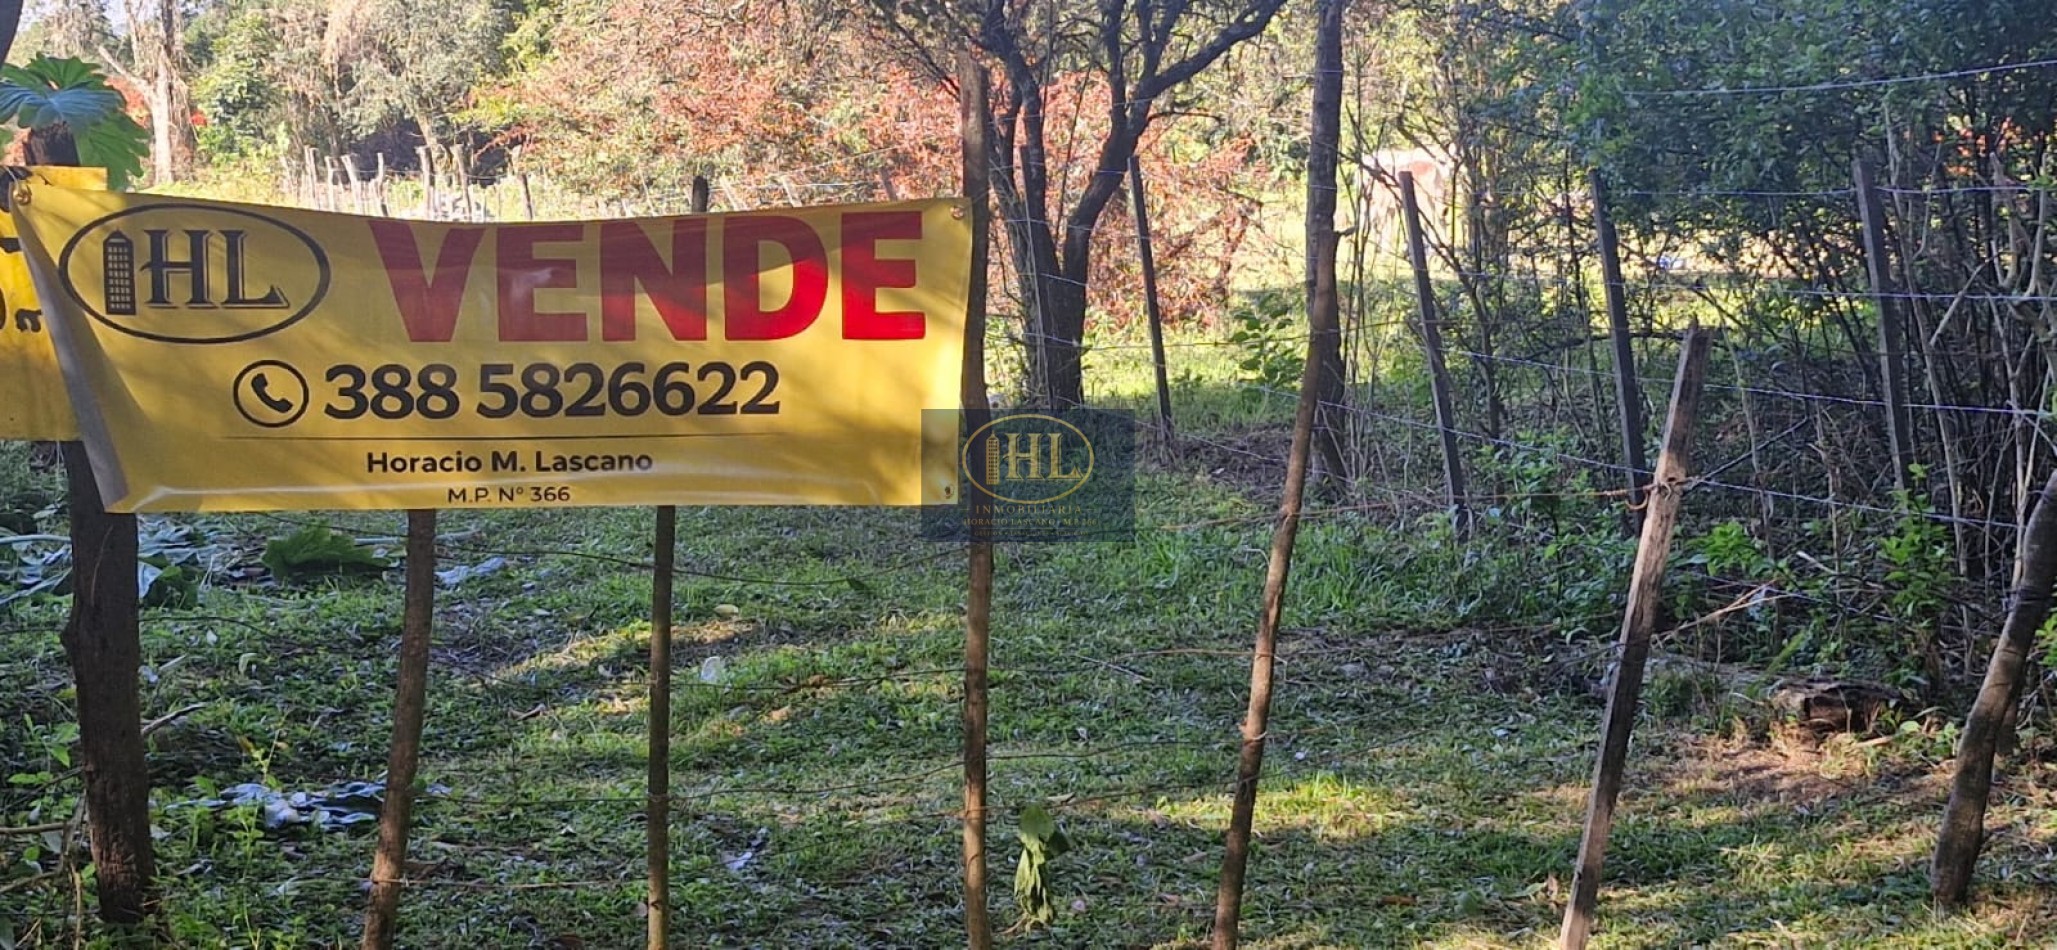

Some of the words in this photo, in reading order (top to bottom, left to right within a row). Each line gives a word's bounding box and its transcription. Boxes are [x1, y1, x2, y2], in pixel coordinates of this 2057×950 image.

[144, 228, 291, 309] HL
[367, 211, 927, 343] VENDE
[324, 363, 460, 422] 388
[477, 359, 782, 420] 5826622
[367, 450, 482, 473] Horacio
[491, 451, 526, 472] M.
[535, 450, 653, 472] Lascano
[448, 487, 492, 503] M.P.
[530, 486, 571, 502] 366
